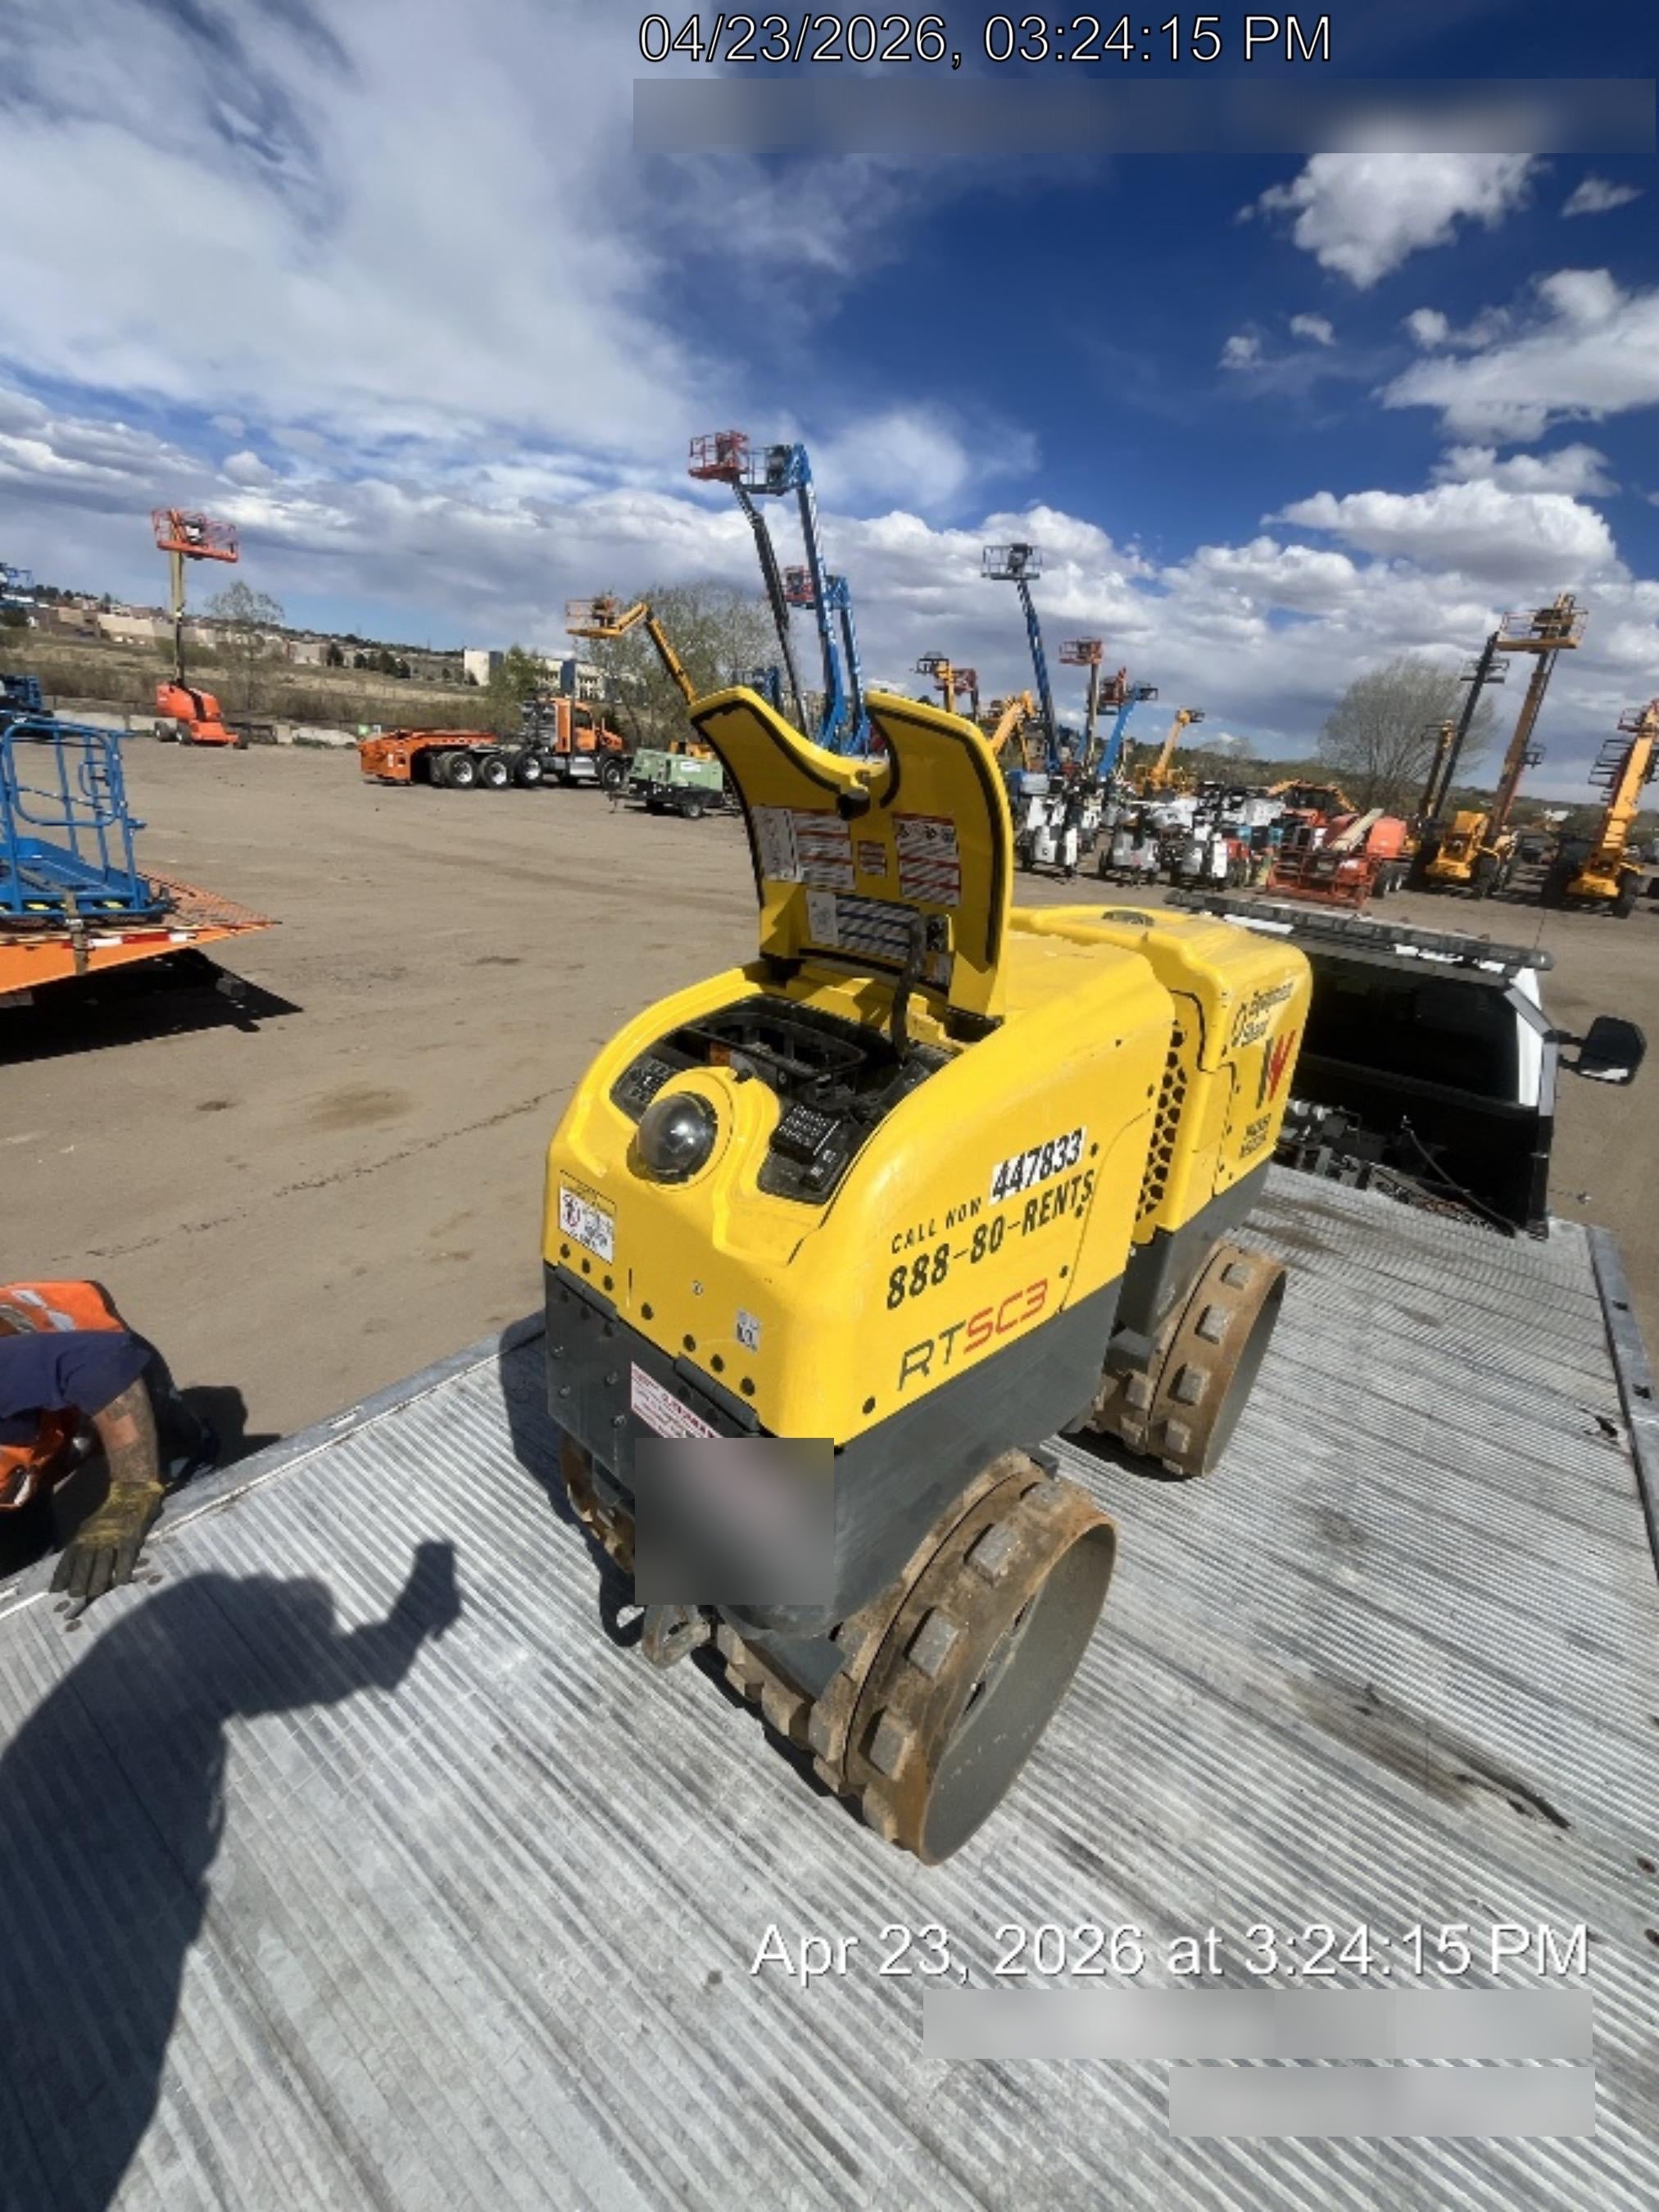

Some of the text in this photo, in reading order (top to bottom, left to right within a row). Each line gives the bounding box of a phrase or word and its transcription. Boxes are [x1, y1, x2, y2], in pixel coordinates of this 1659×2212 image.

[992, 1126, 1083, 1202] 447833
[886, 1168, 1095, 1311] 888-80-RENTS
[891, 1196, 981, 1254] CALL NOW
[896, 1277, 1049, 1392] RTSC3
